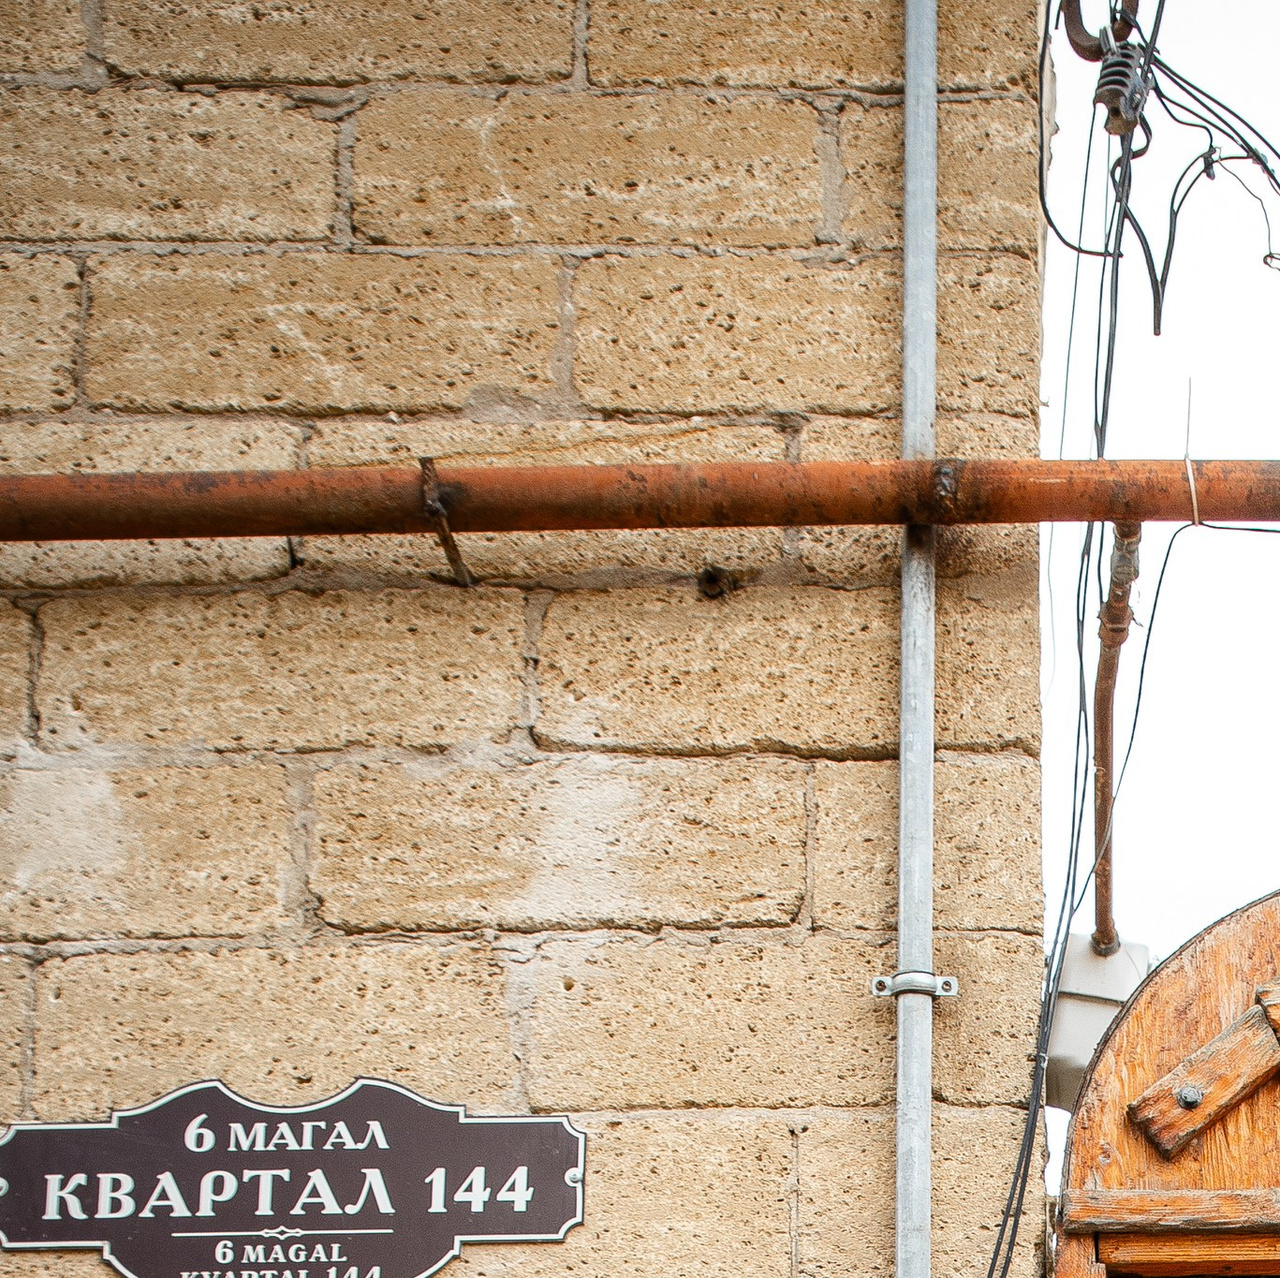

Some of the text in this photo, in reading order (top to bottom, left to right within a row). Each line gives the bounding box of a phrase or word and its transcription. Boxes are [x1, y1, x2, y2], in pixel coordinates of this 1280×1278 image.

[184, 1113, 390, 1152] 6 МАГАЛ
[41, 1166, 535, 1220] КВАРТАЛ 144
[215, 1240, 348, 1264] 6 MAGAL
